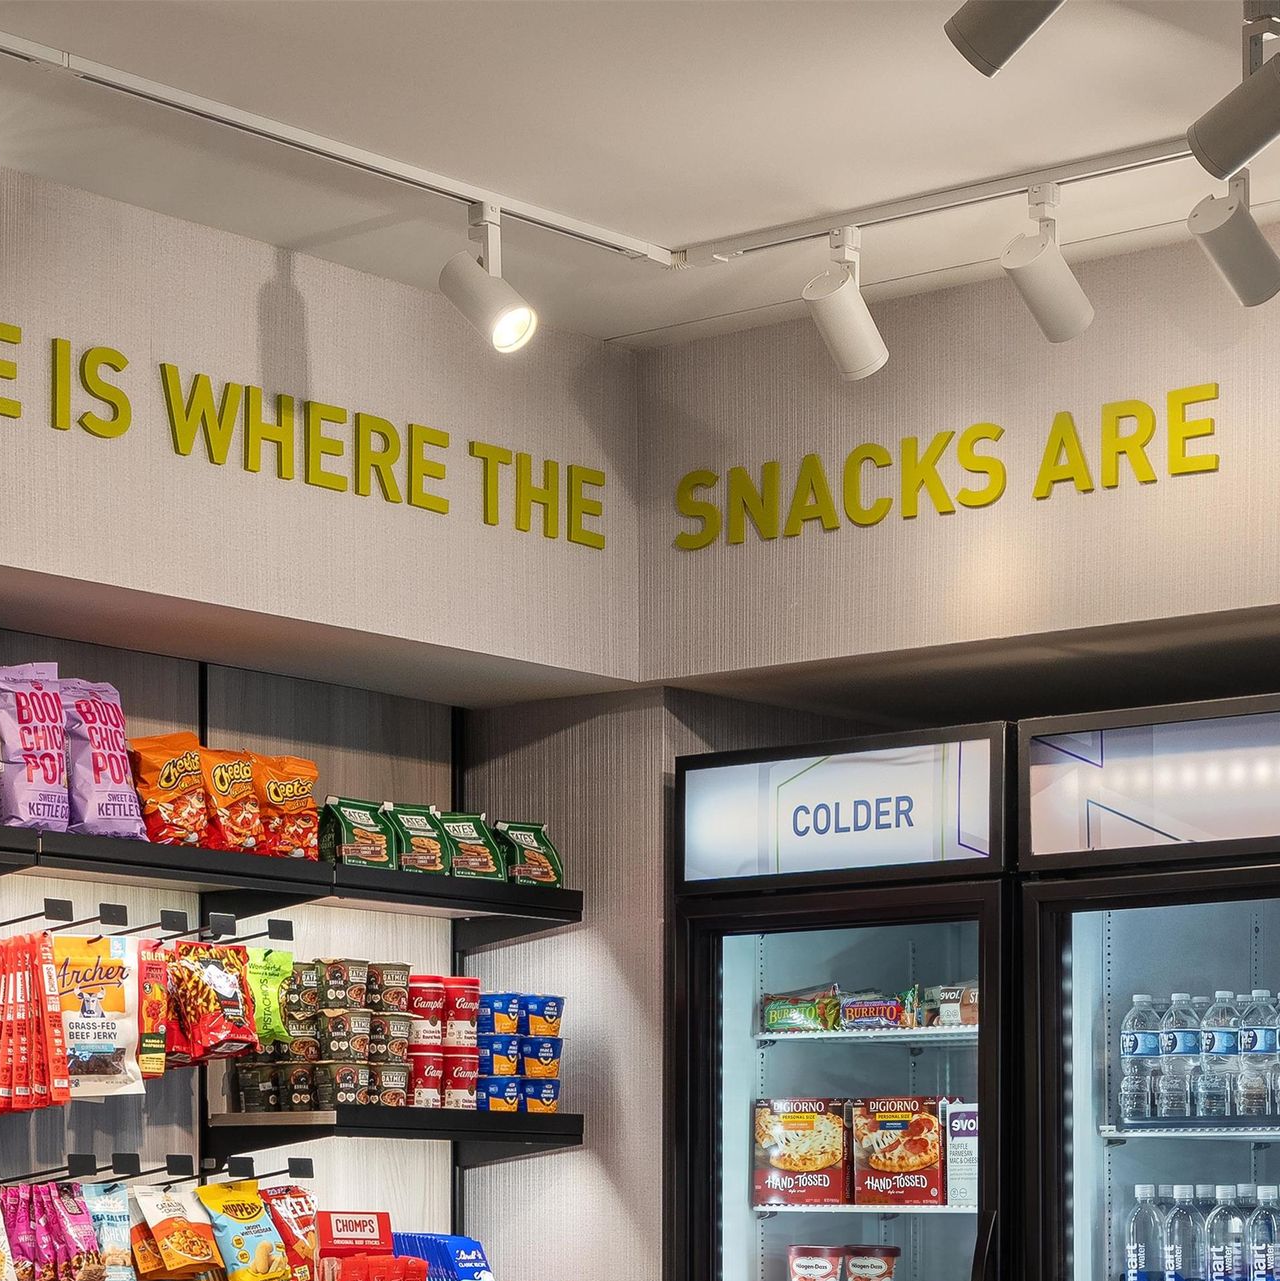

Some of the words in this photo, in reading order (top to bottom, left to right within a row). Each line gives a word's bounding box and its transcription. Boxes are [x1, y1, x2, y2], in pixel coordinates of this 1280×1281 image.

[52, 339, 131, 438] IS
[161, 364, 449, 514] WHERE
[469, 442, 605, 549] THE
[675, 423, 1006, 550] SNACKS
[1033, 384, 1219, 500] ARE
[792, 794, 915, 837] COLDER
[57, 956, 129, 988] Archer
[845, 1004, 898, 1022] BURRITO
[68, 1021, 117, 1030] GRASS-FED
[68, 1031, 90, 1040] BEEF
[92, 1031, 118, 1040] JERKY
[773, 1100, 825, 1113] DIGIORNO
[869, 1099, 920, 1113] DIGIORNO
[764, 1172, 830, 1189] HAND-TOSSED
[864, 1174, 928, 1190] HAND-TOSSED
[335, 1218, 376, 1234] CHOMPS
